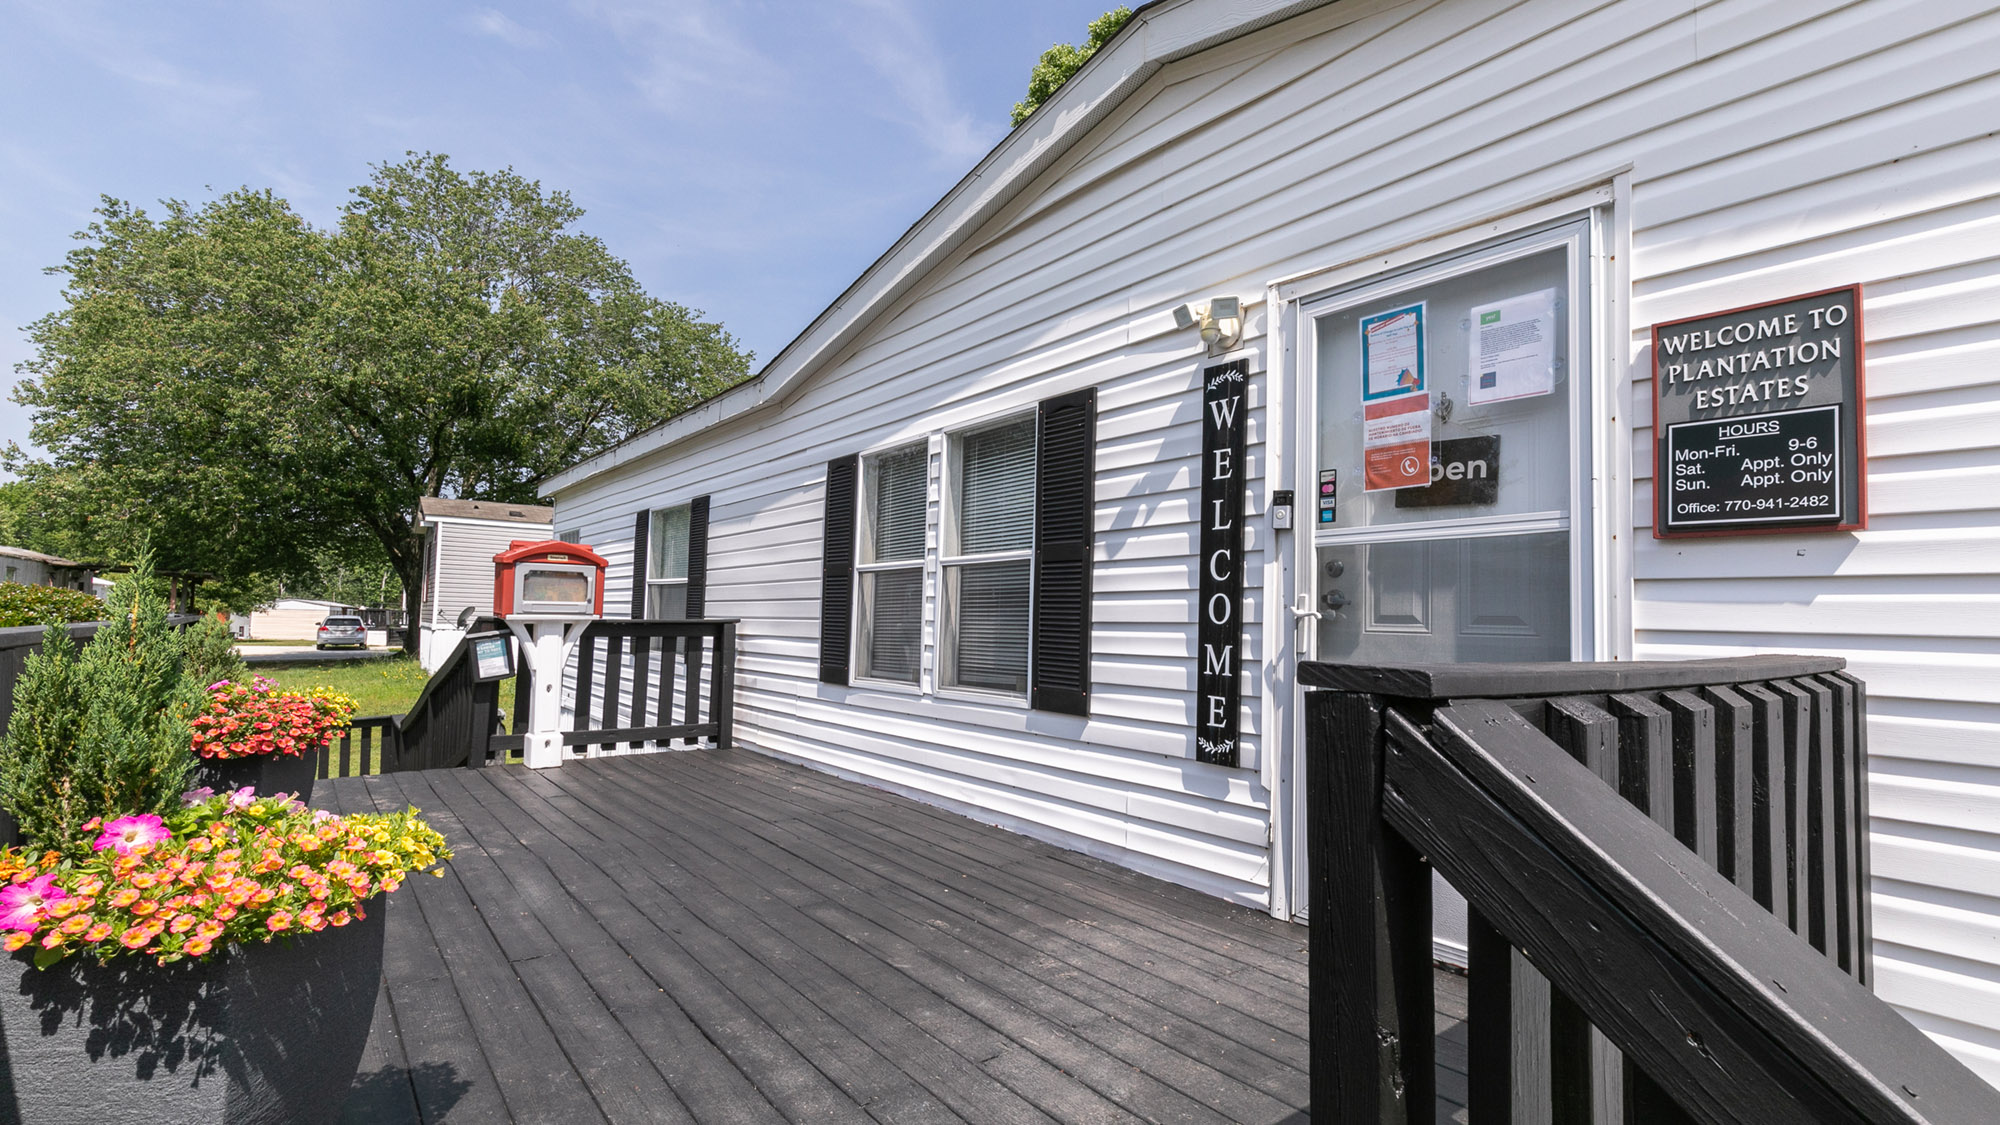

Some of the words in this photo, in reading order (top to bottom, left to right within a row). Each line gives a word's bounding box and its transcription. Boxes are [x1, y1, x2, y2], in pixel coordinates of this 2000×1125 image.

[1663, 314, 1799, 355] WELCOME
[1809, 304, 1848, 329] TO
[1668, 337, 1841, 384] PLANTATION
[1696, 375, 1810, 409] ESTATES
[1718, 420, 1780, 438] HOURS
[1675, 444, 1740, 461] Mon-Fri.
[1788, 436, 1818, 451] 9-6
[1675, 463, 1706, 476] Sat.
[1740, 456, 1785, 472] Appt.
[1790, 451, 1833, 467] Only
[1675, 478, 1710, 491] Sun.
[1740, 472, 1785, 488] Appt.
[1790, 468, 1833, 484] Only
[1677, 502, 1720, 514] Office:
[1724, 495, 1829, 511] 770-941-2482
[1203, 395, 1240, 729] WELCOME
